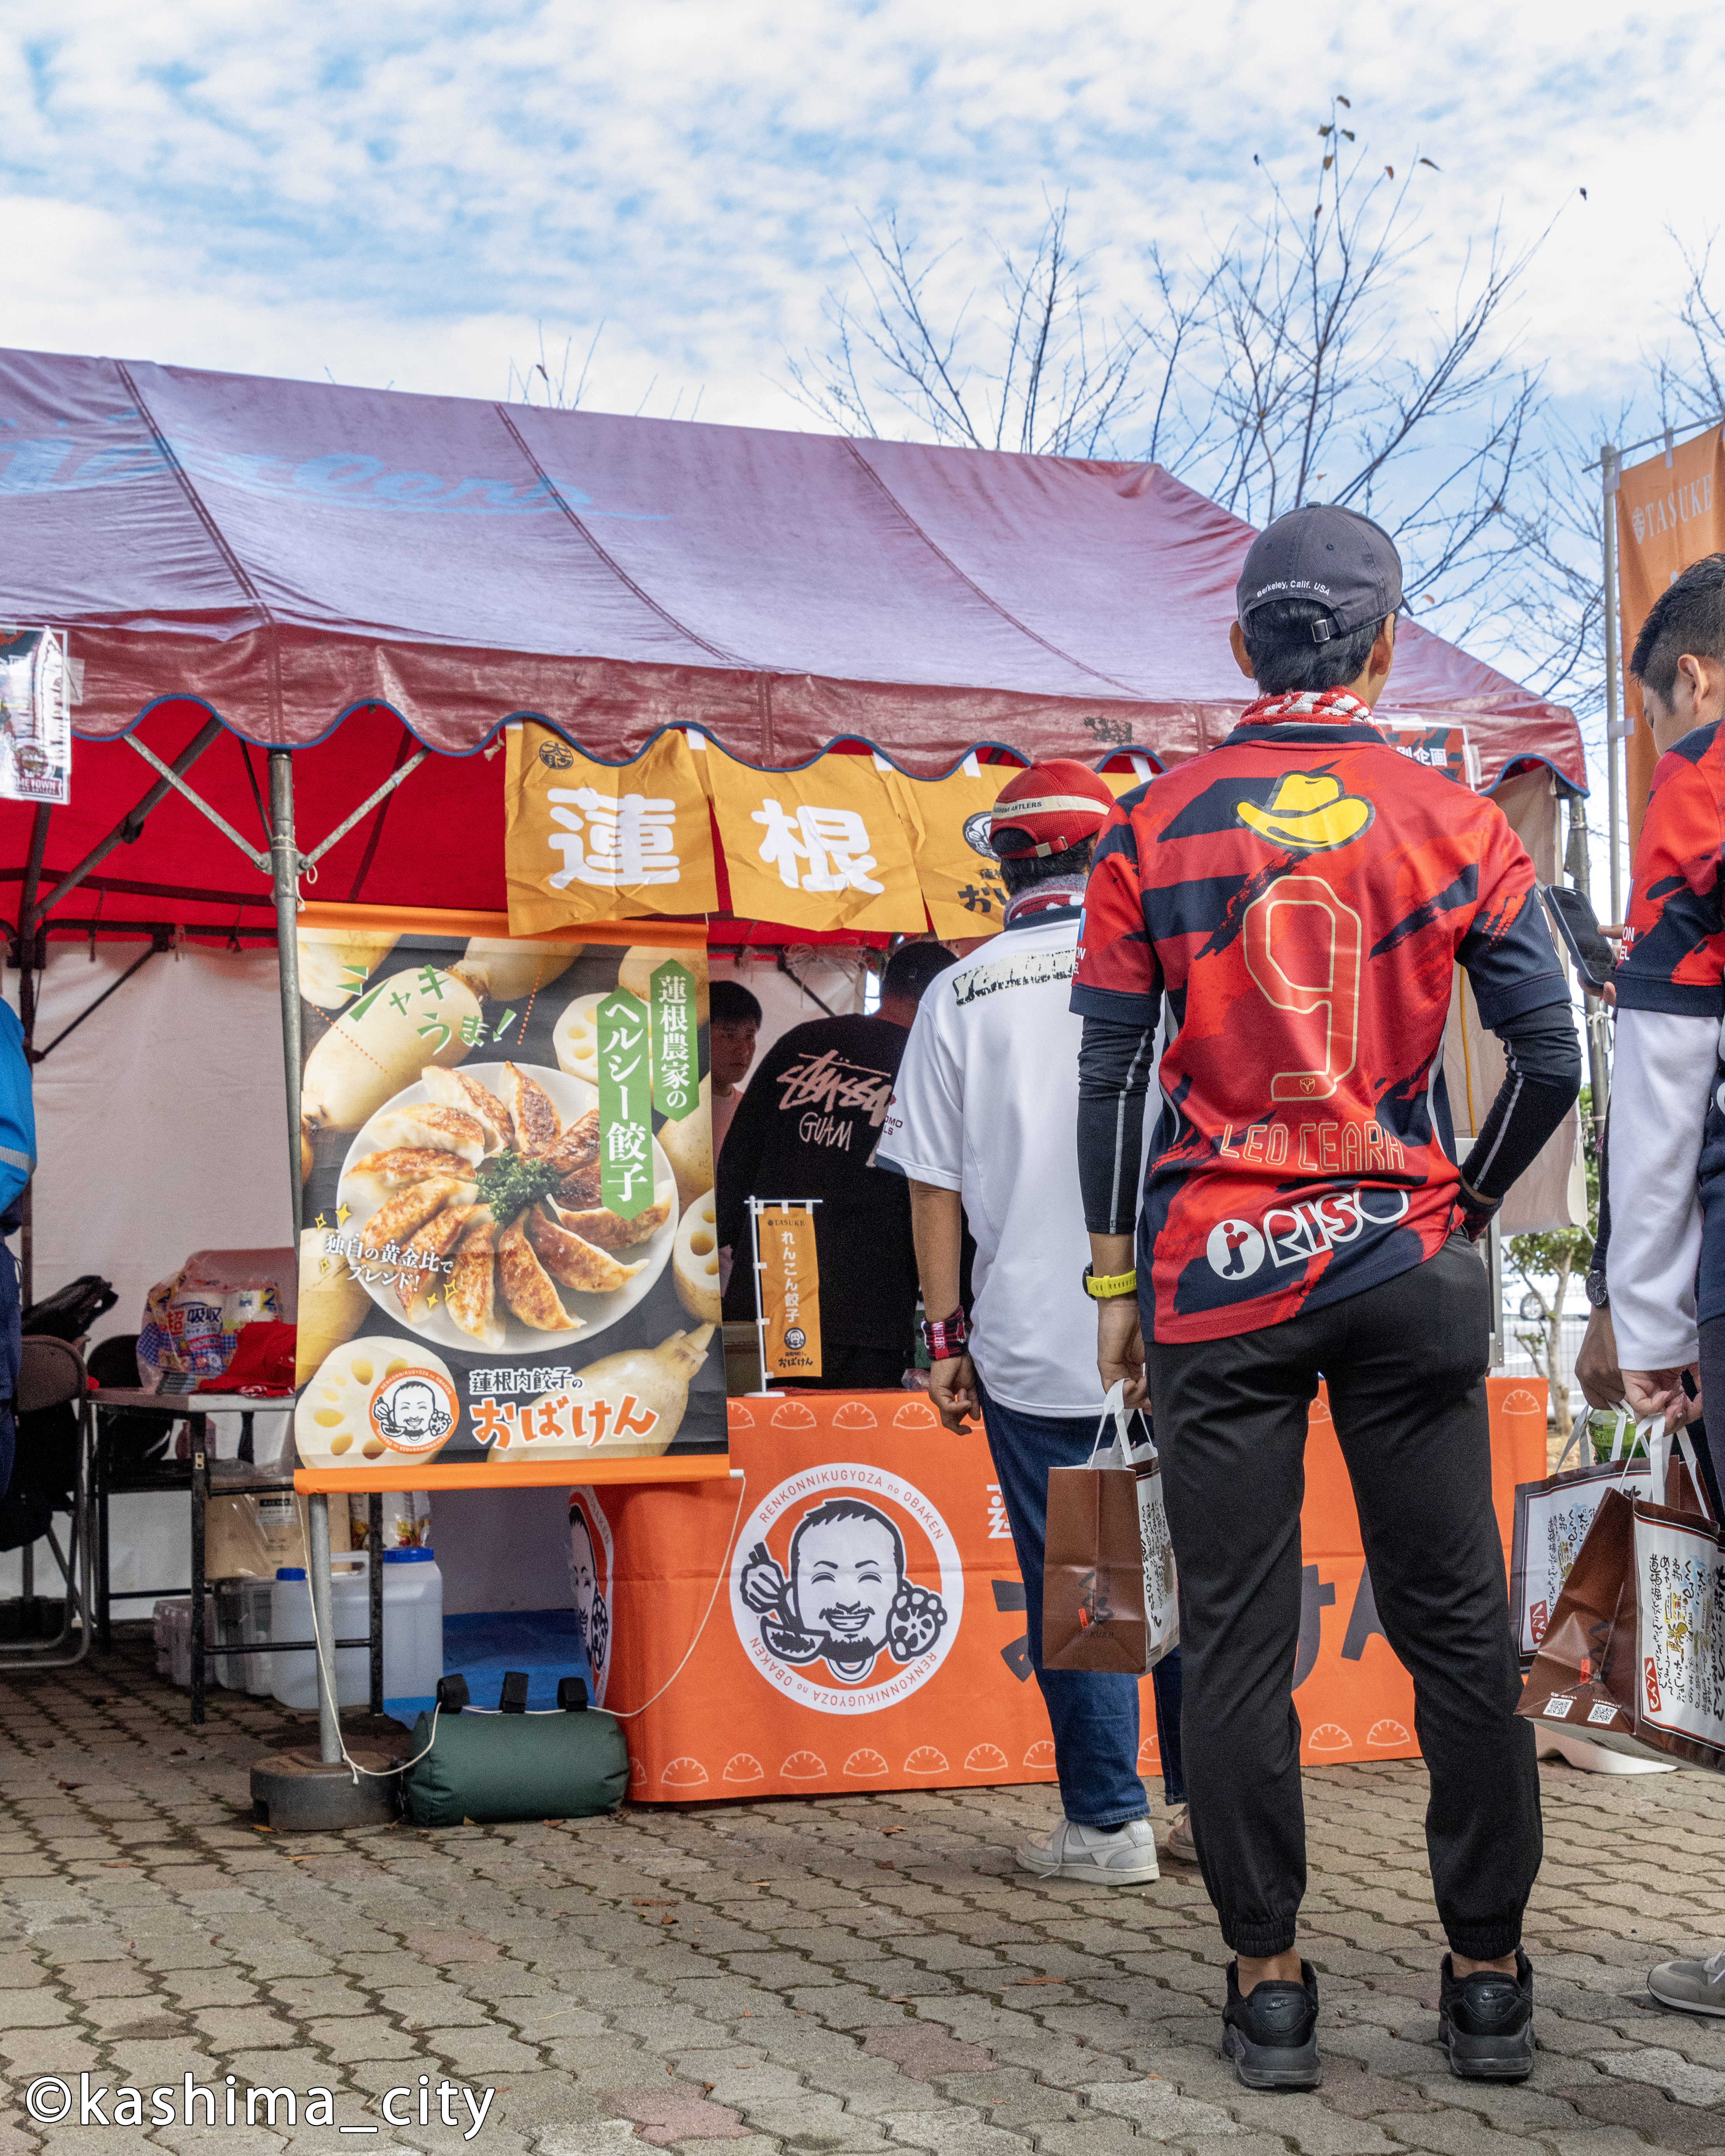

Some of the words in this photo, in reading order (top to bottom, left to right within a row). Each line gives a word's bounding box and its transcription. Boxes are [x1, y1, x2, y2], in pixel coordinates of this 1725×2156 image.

[1645, 474, 1711, 537] TASUKE
[1257, 581, 1288, 598] Berkeley,
[1290, 580, 1311, 589] Calif.
[1314, 583, 1330, 596] USA
[1011, 802, 1042, 811] ANTLERS
[1243, 876, 1361, 1102] 9
[658, 976, 691, 1109] 蓮根農家の
[602, 1003, 647, 1202] ヘルシー餃子
[1220, 1123, 1288, 1166] LEO
[325, 1233, 454, 1275] 独自の黄金比で
[781, 1231, 800, 1324] れんこん餃子
[470, 1367, 584, 1394] 蓮根肉餃子の
[470, 1393, 659, 1450] おばけん
[759, 1470, 882, 1523] RENKONNIKUGYOZA
[903, 1492, 944, 1540] OBAKEN
[749, 1637, 793, 1687] OBAKEN
[813, 1652, 938, 1707] RENKONNIKUGYOZA
[1646, 1661, 1659, 1709] くくる
[1133, 1824, 1150, 1835] NIKE
